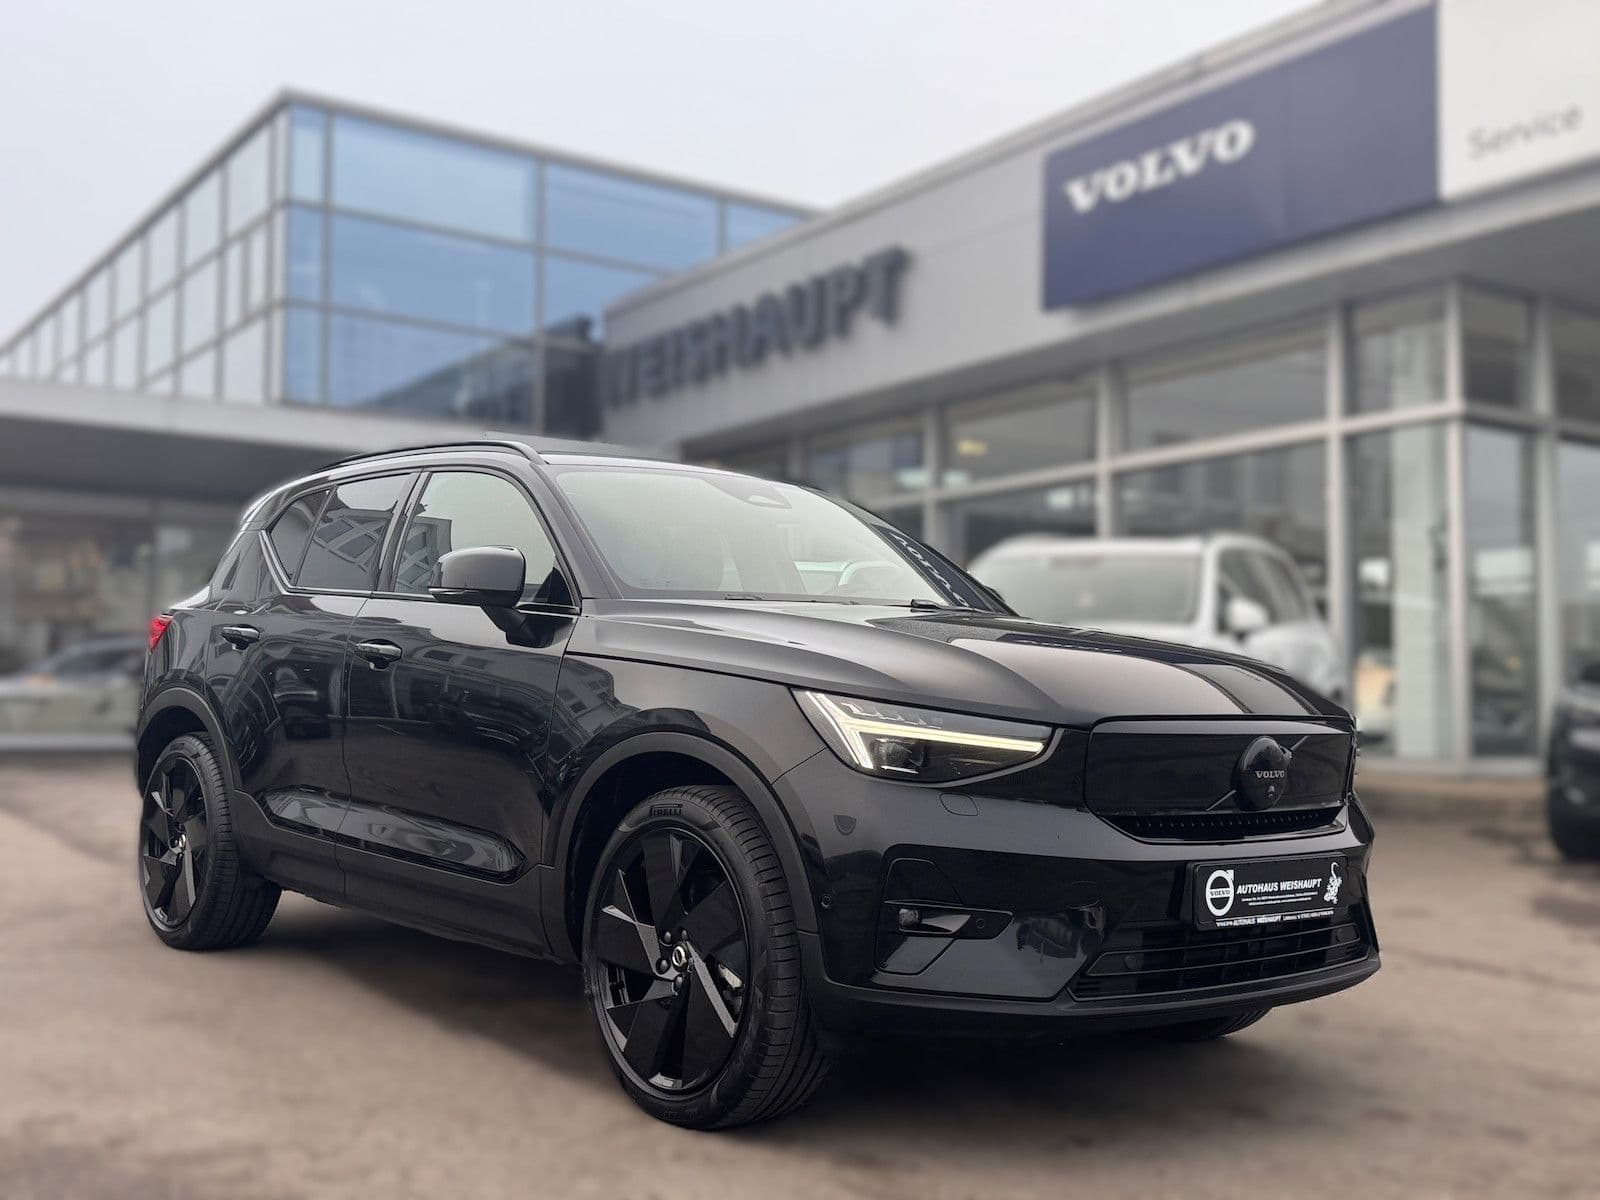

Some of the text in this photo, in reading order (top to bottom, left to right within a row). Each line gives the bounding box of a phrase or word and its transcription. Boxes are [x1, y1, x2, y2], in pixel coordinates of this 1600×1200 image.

[1466, 105, 1582, 160] Service
[1065, 119, 1255, 213] VOLVO
[1255, 770, 1285, 778] VOLVO
[650, 803, 683, 817] PIRELLI
[1236, 878, 1322, 895] AUTOHAUS WEISHAUPT
